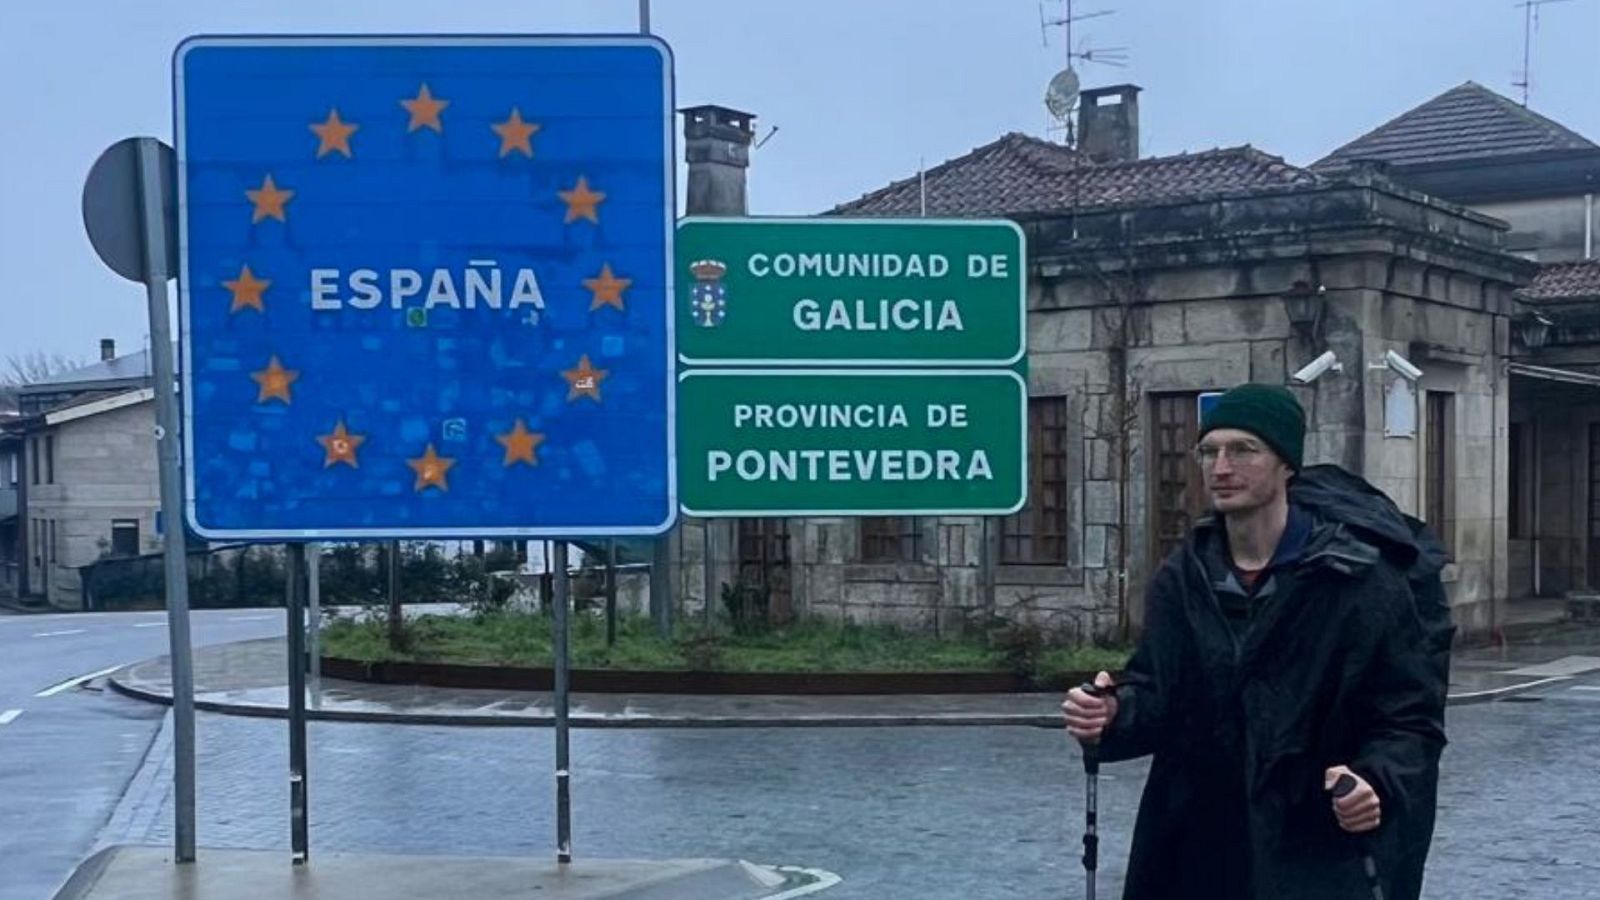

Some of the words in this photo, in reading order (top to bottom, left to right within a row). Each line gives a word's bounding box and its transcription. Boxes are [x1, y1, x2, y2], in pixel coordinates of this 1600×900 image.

[748, 253, 949, 278] COMUNIDAD
[967, 254, 1009, 278] DE
[310, 259, 546, 310] ESPAÑA
[792, 299, 965, 332] GALICIA
[733, 404, 909, 428] PROVINCIA
[927, 404, 969, 428] DE
[707, 449, 994, 482] PONTEVEDRA
